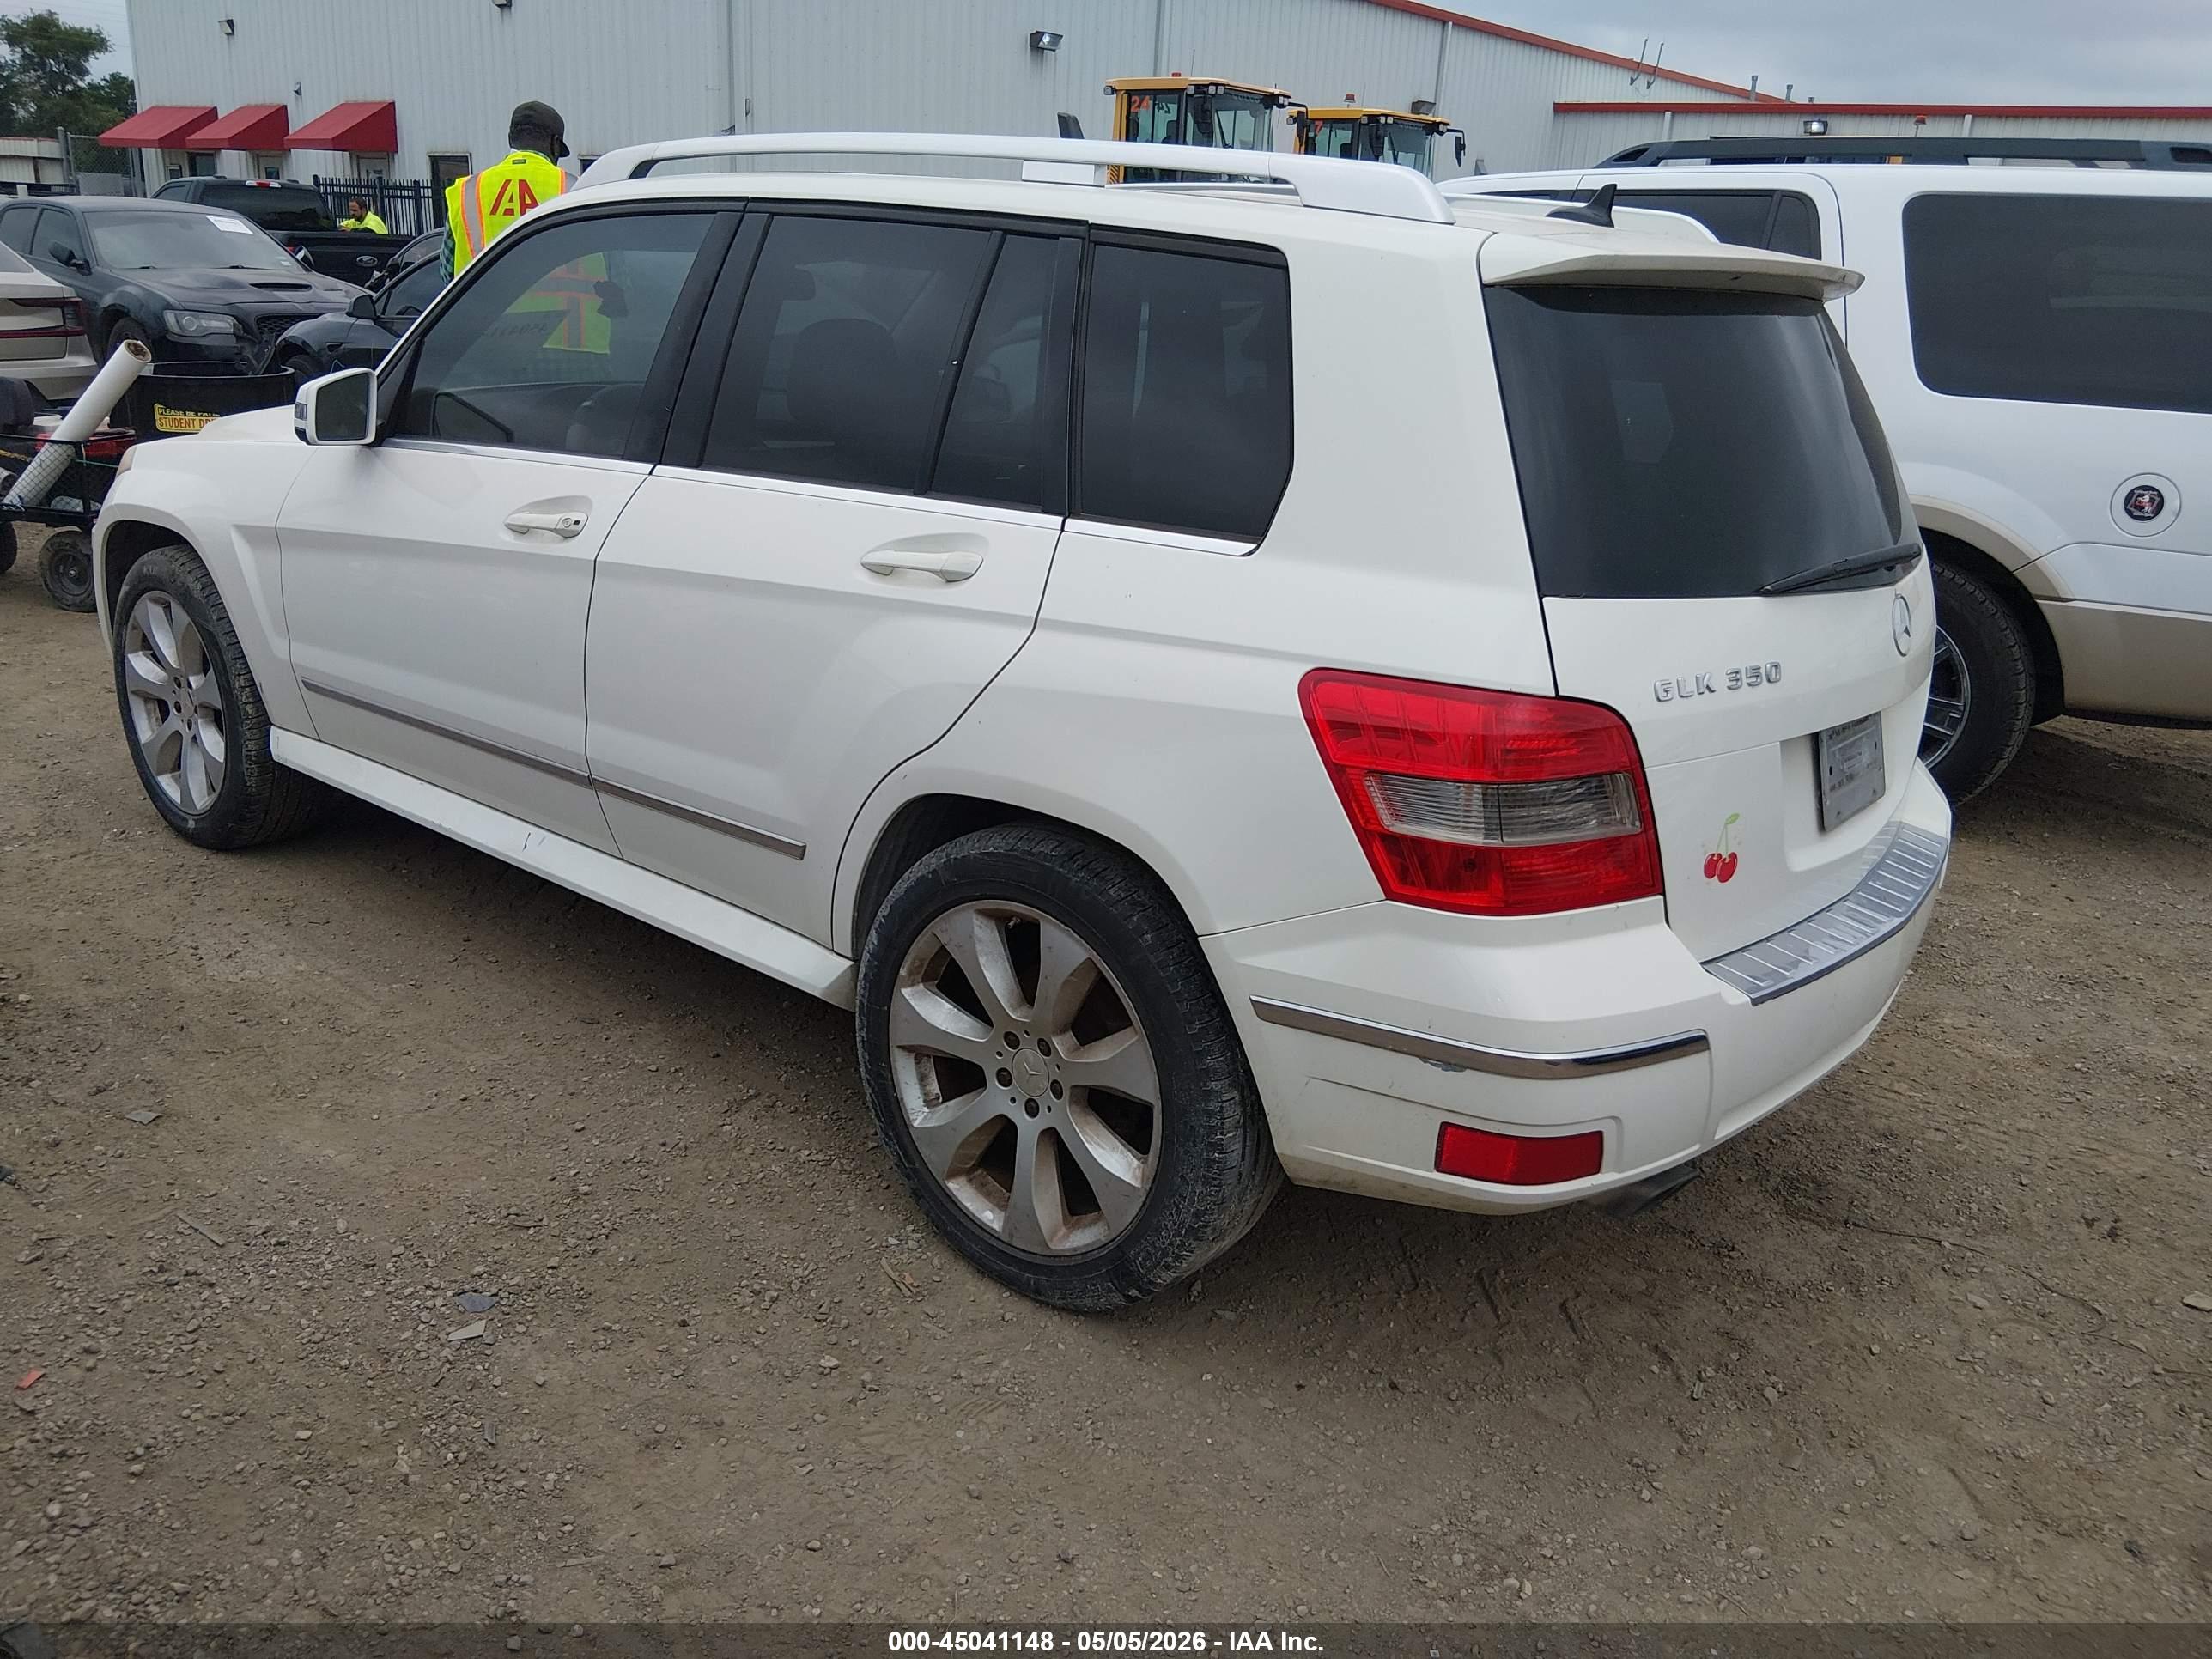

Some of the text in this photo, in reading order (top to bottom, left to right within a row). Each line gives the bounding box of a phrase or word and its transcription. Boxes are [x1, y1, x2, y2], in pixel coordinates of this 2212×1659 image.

[1130, 95, 1150, 112] 24
[158, 407, 185, 416] PLEASE
[158, 417, 197, 429] STUDENT
[1654, 662, 1782, 702] GLK 350
